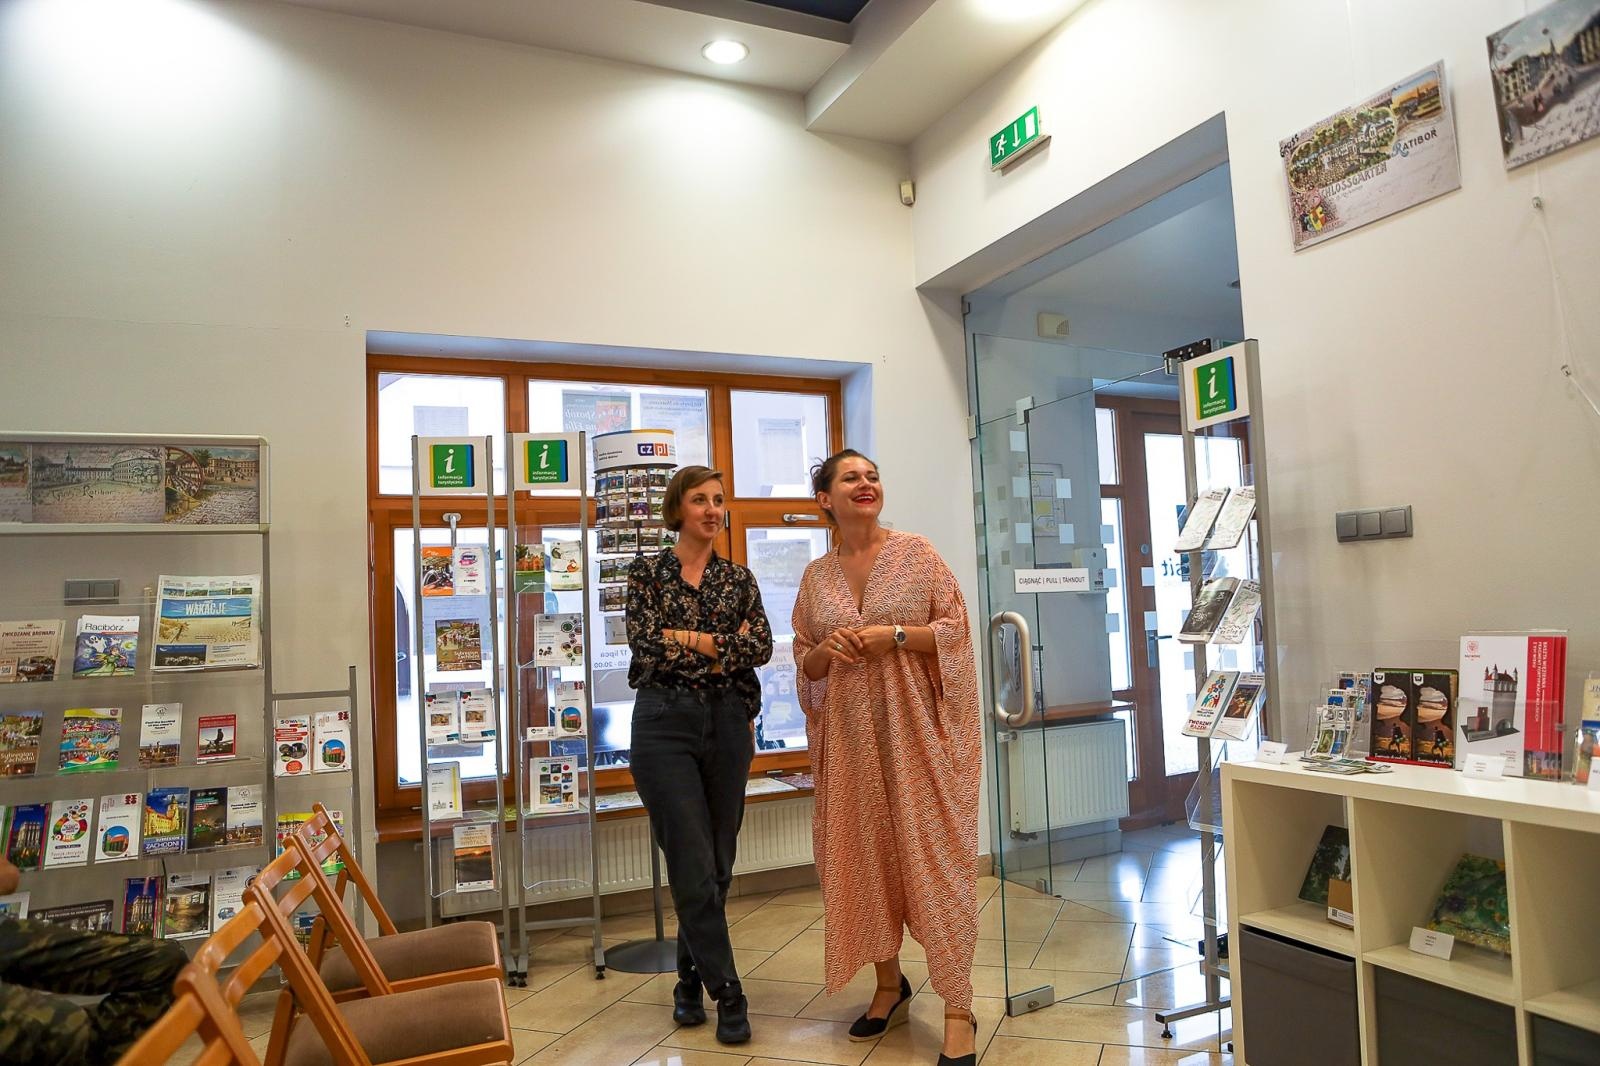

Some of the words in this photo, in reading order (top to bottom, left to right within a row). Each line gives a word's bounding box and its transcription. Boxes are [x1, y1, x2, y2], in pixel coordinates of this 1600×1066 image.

[1391, 129, 1437, 157] RATIBOR
[1203, 398, 1226, 408] informacja
[185, 602, 226, 615] WAKACJE
[84, 622, 124, 631] Racibórz
[145, 840, 179, 850] ZACHODNI
